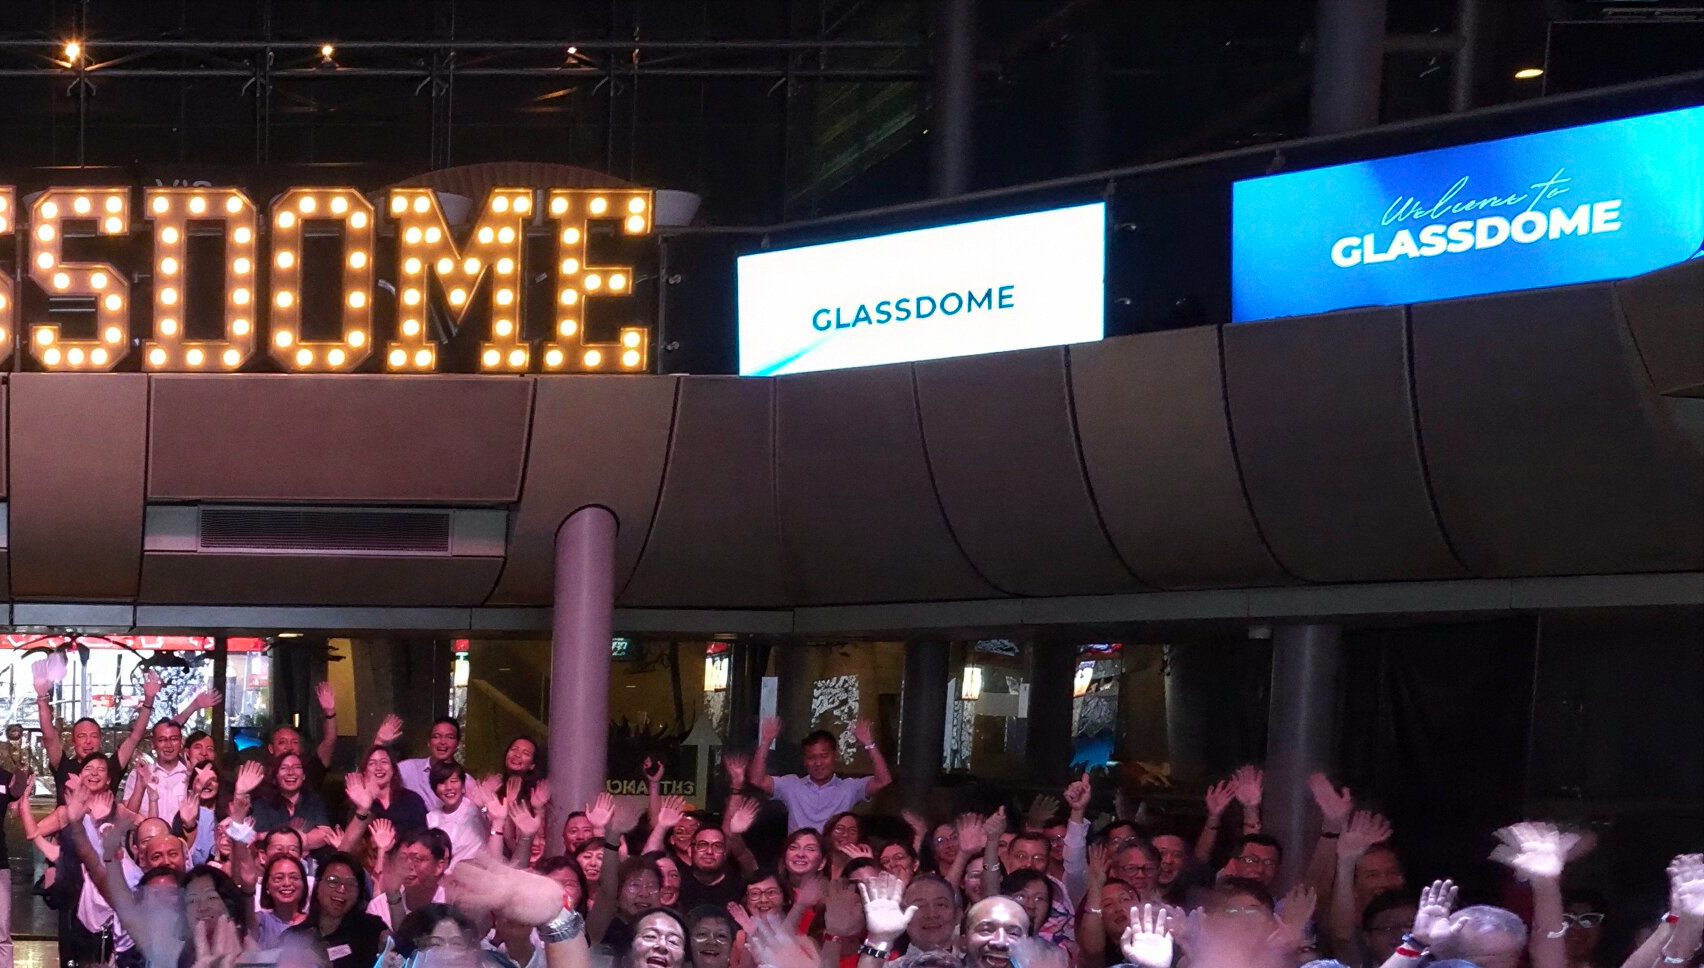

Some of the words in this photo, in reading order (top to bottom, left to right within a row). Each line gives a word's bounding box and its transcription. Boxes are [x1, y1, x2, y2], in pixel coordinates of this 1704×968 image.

[1381, 176, 1528, 226] Welcome
[1526, 167, 1573, 212] to
[1331, 199, 1623, 268] GLASSDOME
[812, 285, 1015, 332] GLASSDOME
